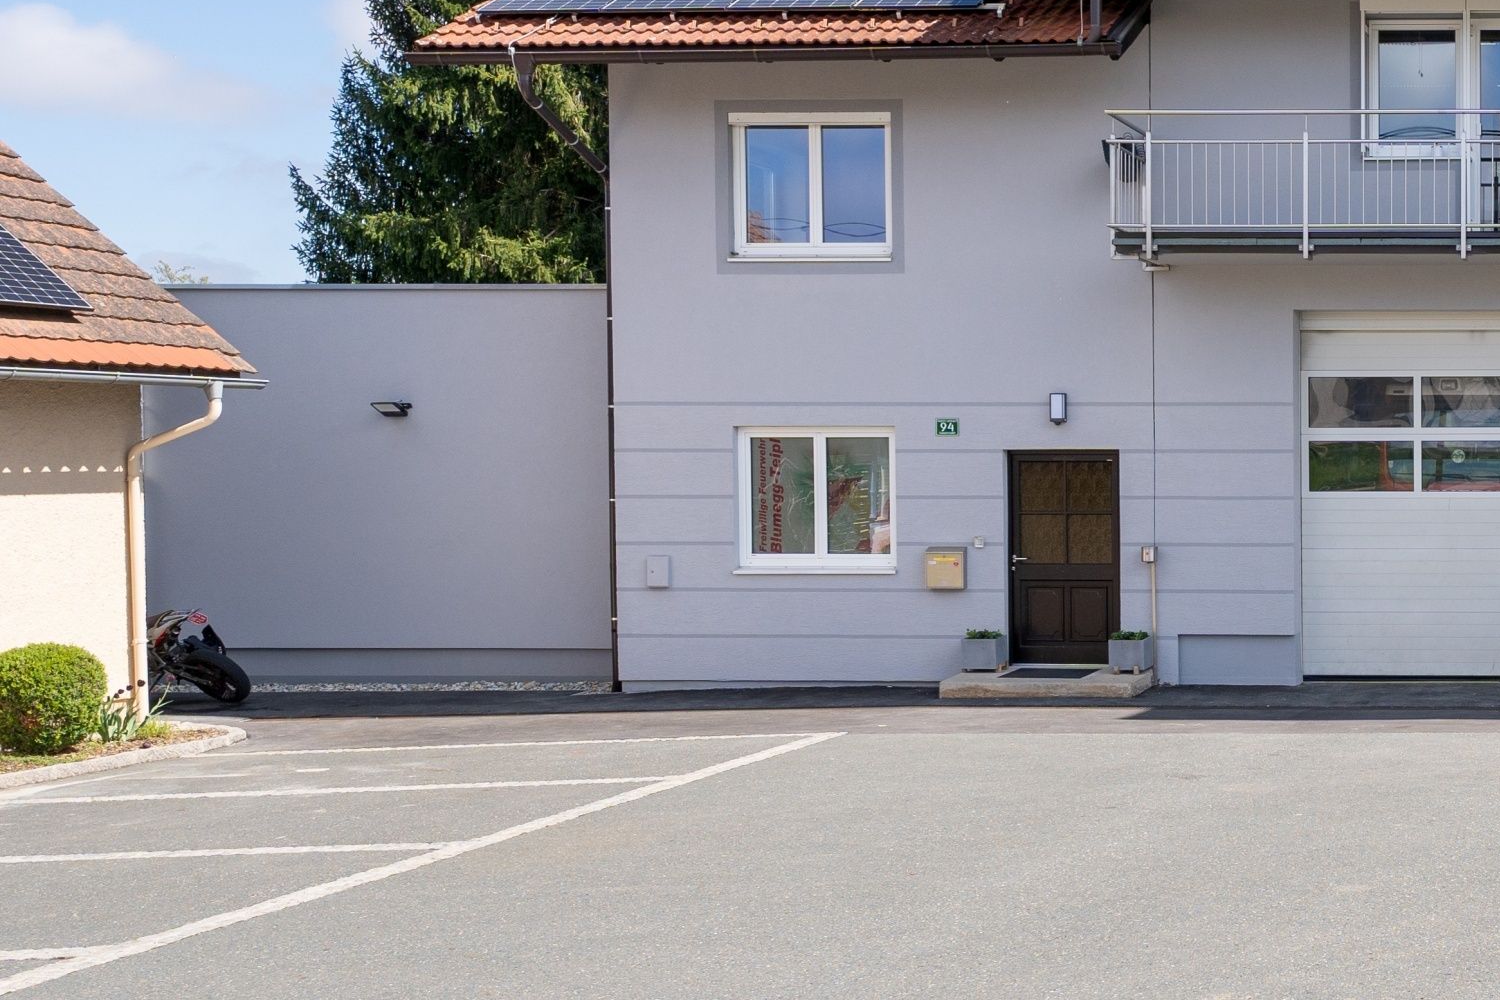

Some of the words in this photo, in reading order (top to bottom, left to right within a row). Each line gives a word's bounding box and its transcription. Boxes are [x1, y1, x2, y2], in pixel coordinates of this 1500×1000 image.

[940, 422, 954, 432] 94
[758, 437, 767, 496] Feuerwehr
[770, 437, 785, 553] Blumegg-Teipl
[758, 499, 769, 552] Freiwillige
